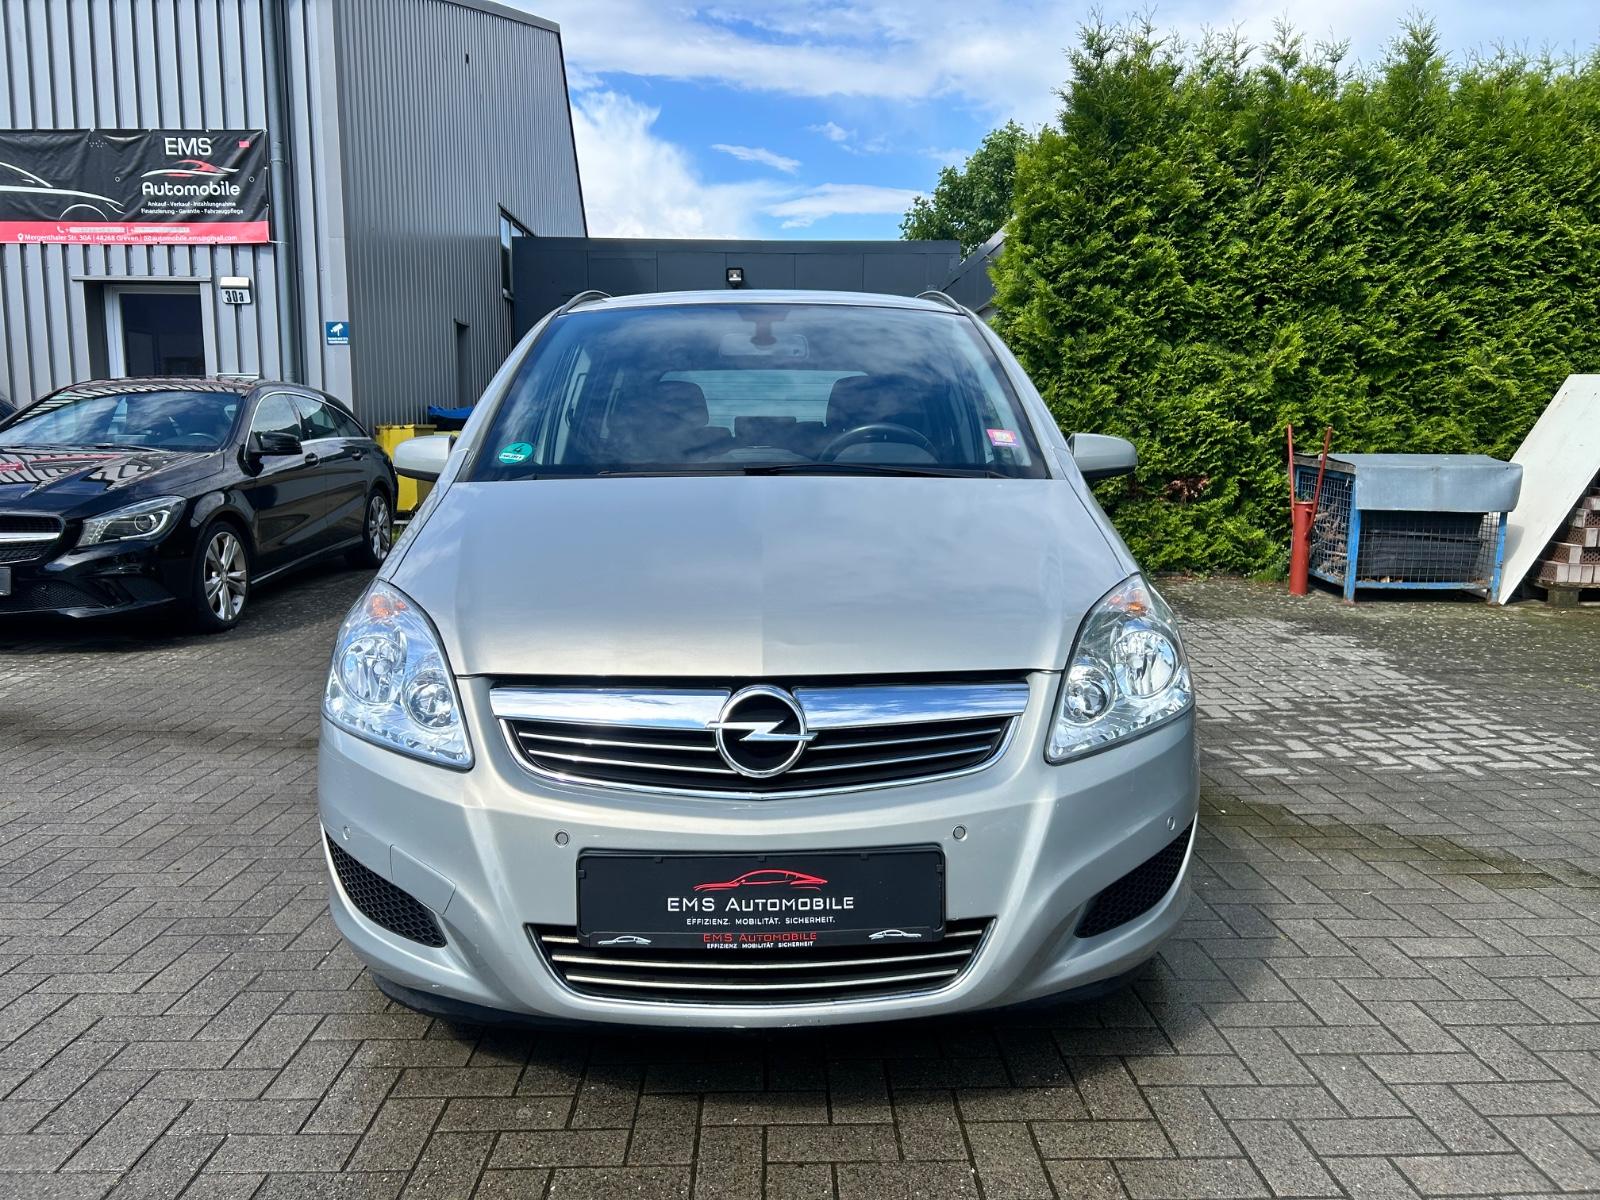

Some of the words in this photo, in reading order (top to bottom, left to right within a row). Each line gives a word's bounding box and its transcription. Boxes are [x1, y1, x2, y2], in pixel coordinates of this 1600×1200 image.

[164, 137, 212, 156] EMS
[141, 181, 240, 196] Automobile
[225, 290, 244, 302] 30a
[667, 897, 715, 912] EMS
[726, 896, 855, 912] AUTOMOBILE
[686, 917, 731, 926] EFFIZIENZ.
[735, 916, 781, 925] MOBILITÄT.
[785, 915, 836, 924] SICHERHEIT.
[703, 933, 733, 943] EMS
[739, 932, 817, 942] AUTOMOBILE
